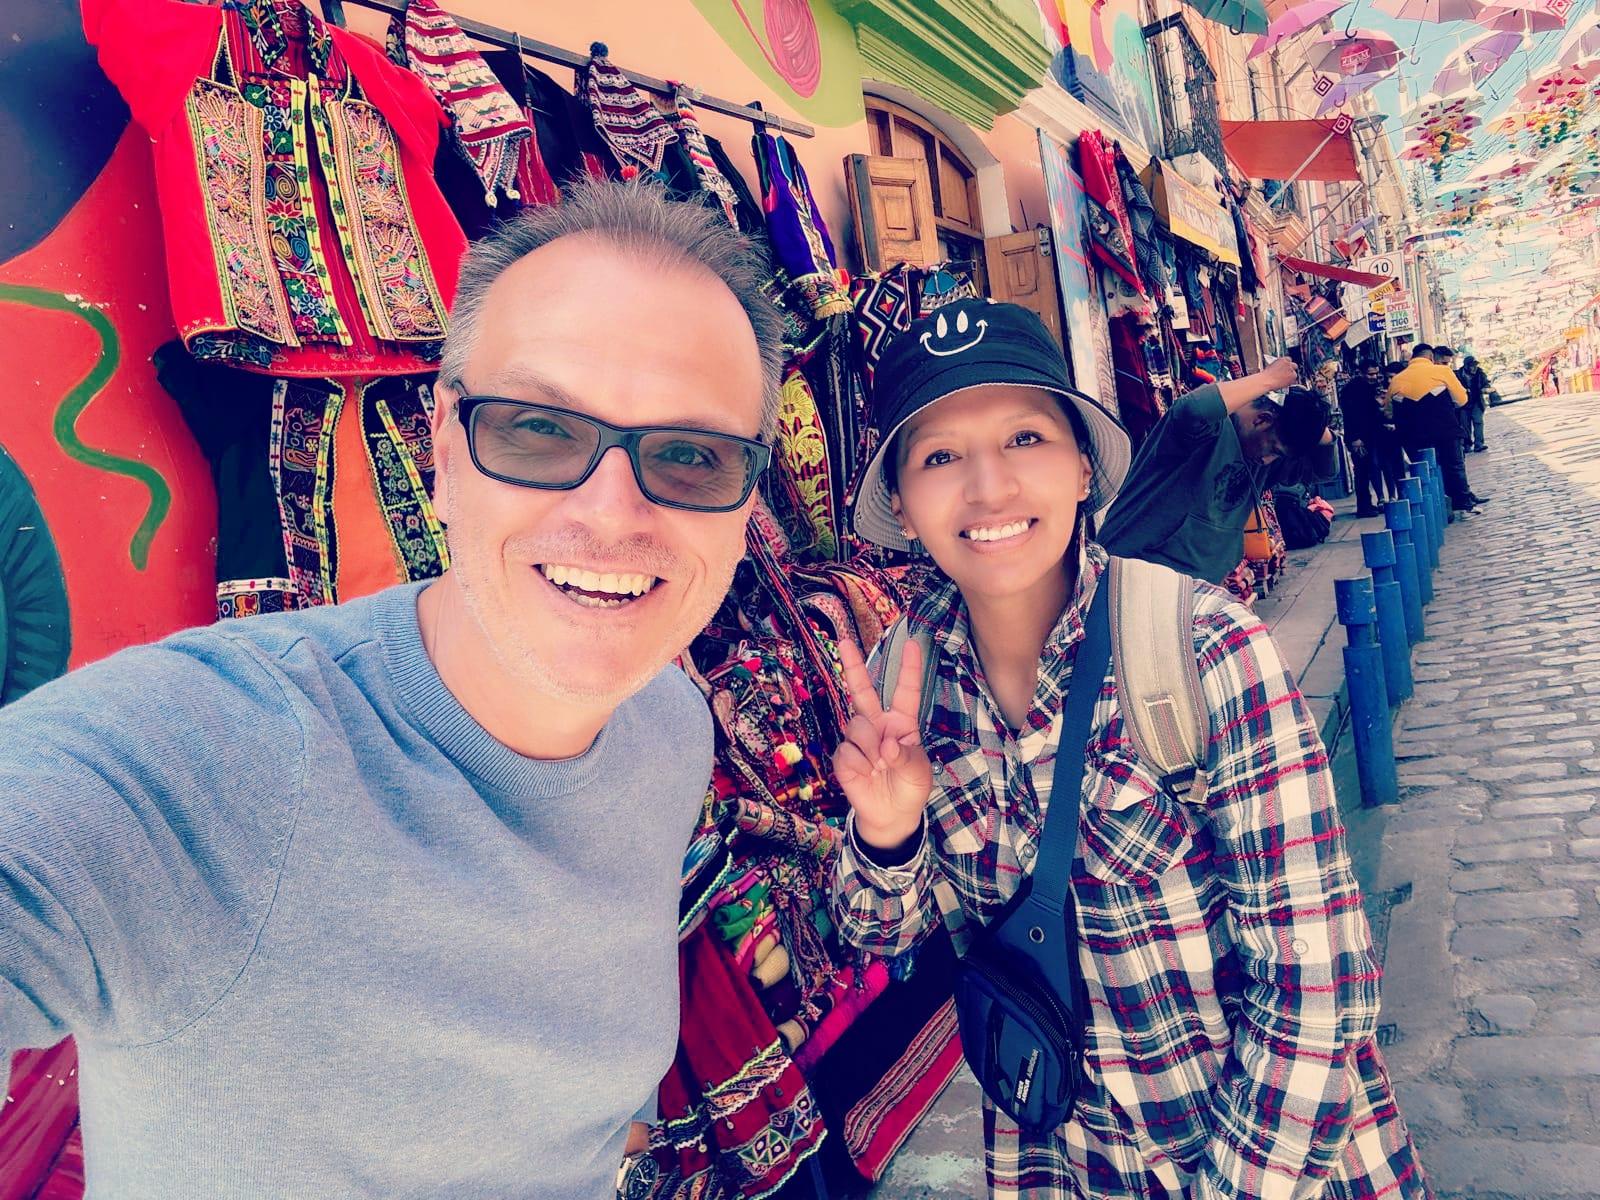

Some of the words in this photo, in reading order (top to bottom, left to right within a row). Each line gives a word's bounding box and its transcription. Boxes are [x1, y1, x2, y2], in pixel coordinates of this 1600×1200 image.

[1374, 262, 1389, 274] 10
[1386, 302, 1410, 312] ENTEL
[1391, 318, 1409, 326] TIGO
